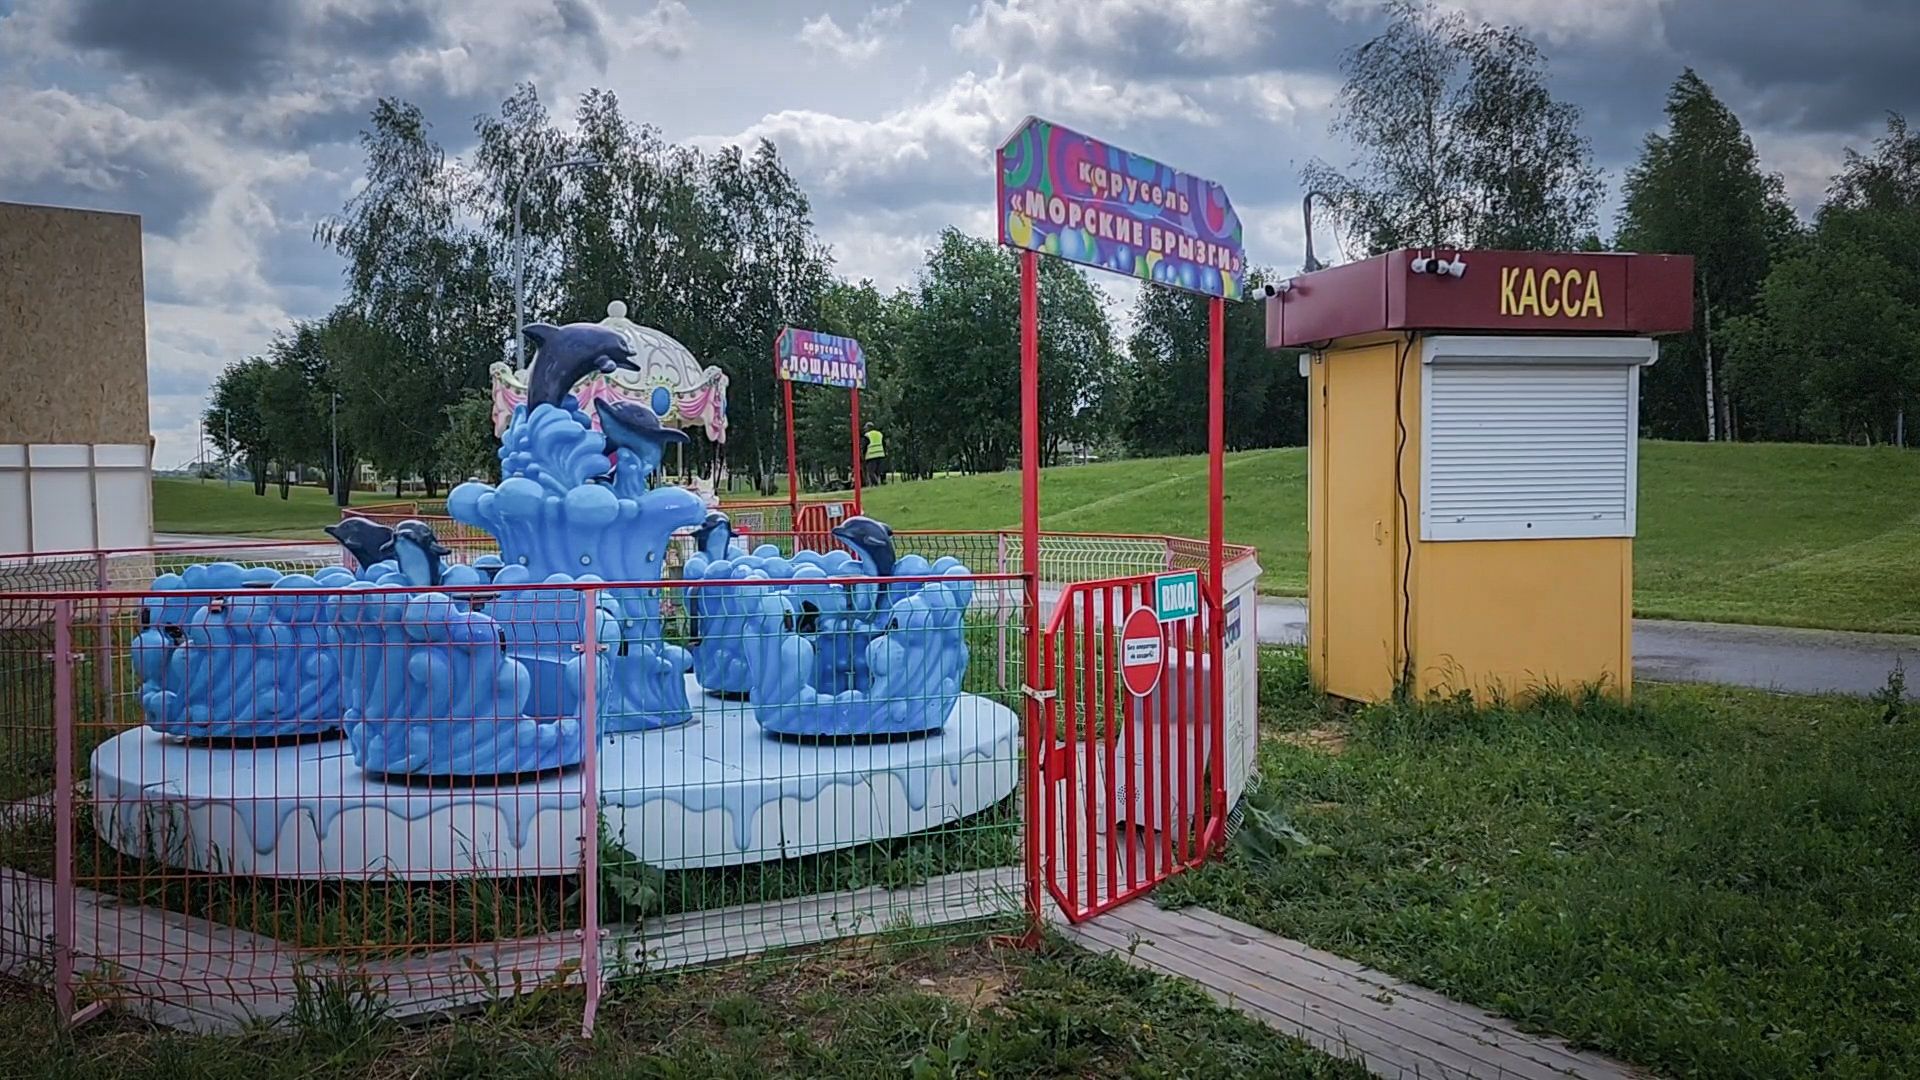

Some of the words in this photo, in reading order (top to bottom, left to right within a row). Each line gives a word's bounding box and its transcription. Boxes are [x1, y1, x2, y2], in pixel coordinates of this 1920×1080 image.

[1010, 189, 1144, 247] «МОРСКИЕ
[1150, 226, 1240, 272] БРЫЗГИ»
[1500, 266, 1604, 319] КАССА
[782, 355, 863, 380] «ЛОШАДКИ»
[1161, 581, 1195, 612] ВХОД
